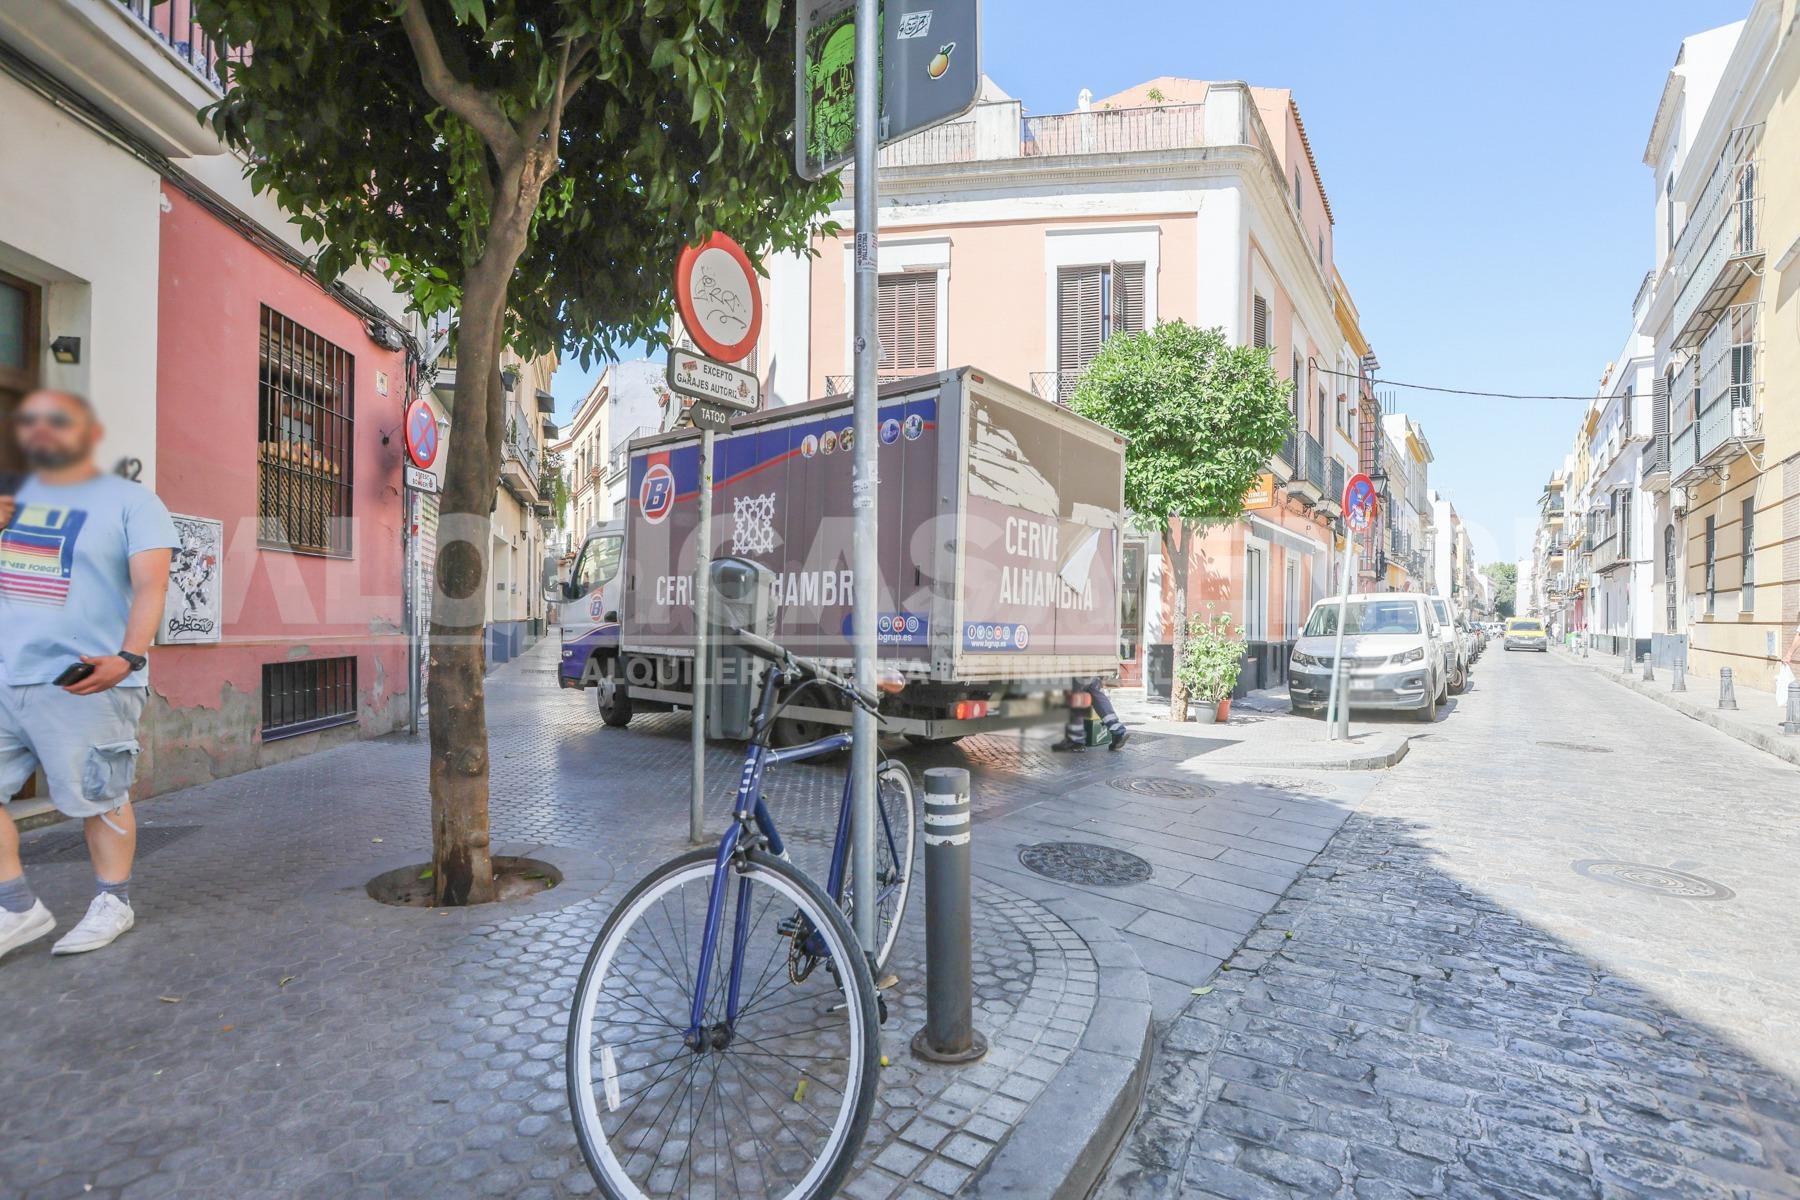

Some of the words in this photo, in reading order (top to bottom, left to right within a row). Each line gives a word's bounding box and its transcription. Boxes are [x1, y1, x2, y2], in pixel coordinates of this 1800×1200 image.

[676, 372, 709, 391] GARAJES
[703, 364, 733, 382] EXCEPTO
[701, 408, 726, 424] TATOO
